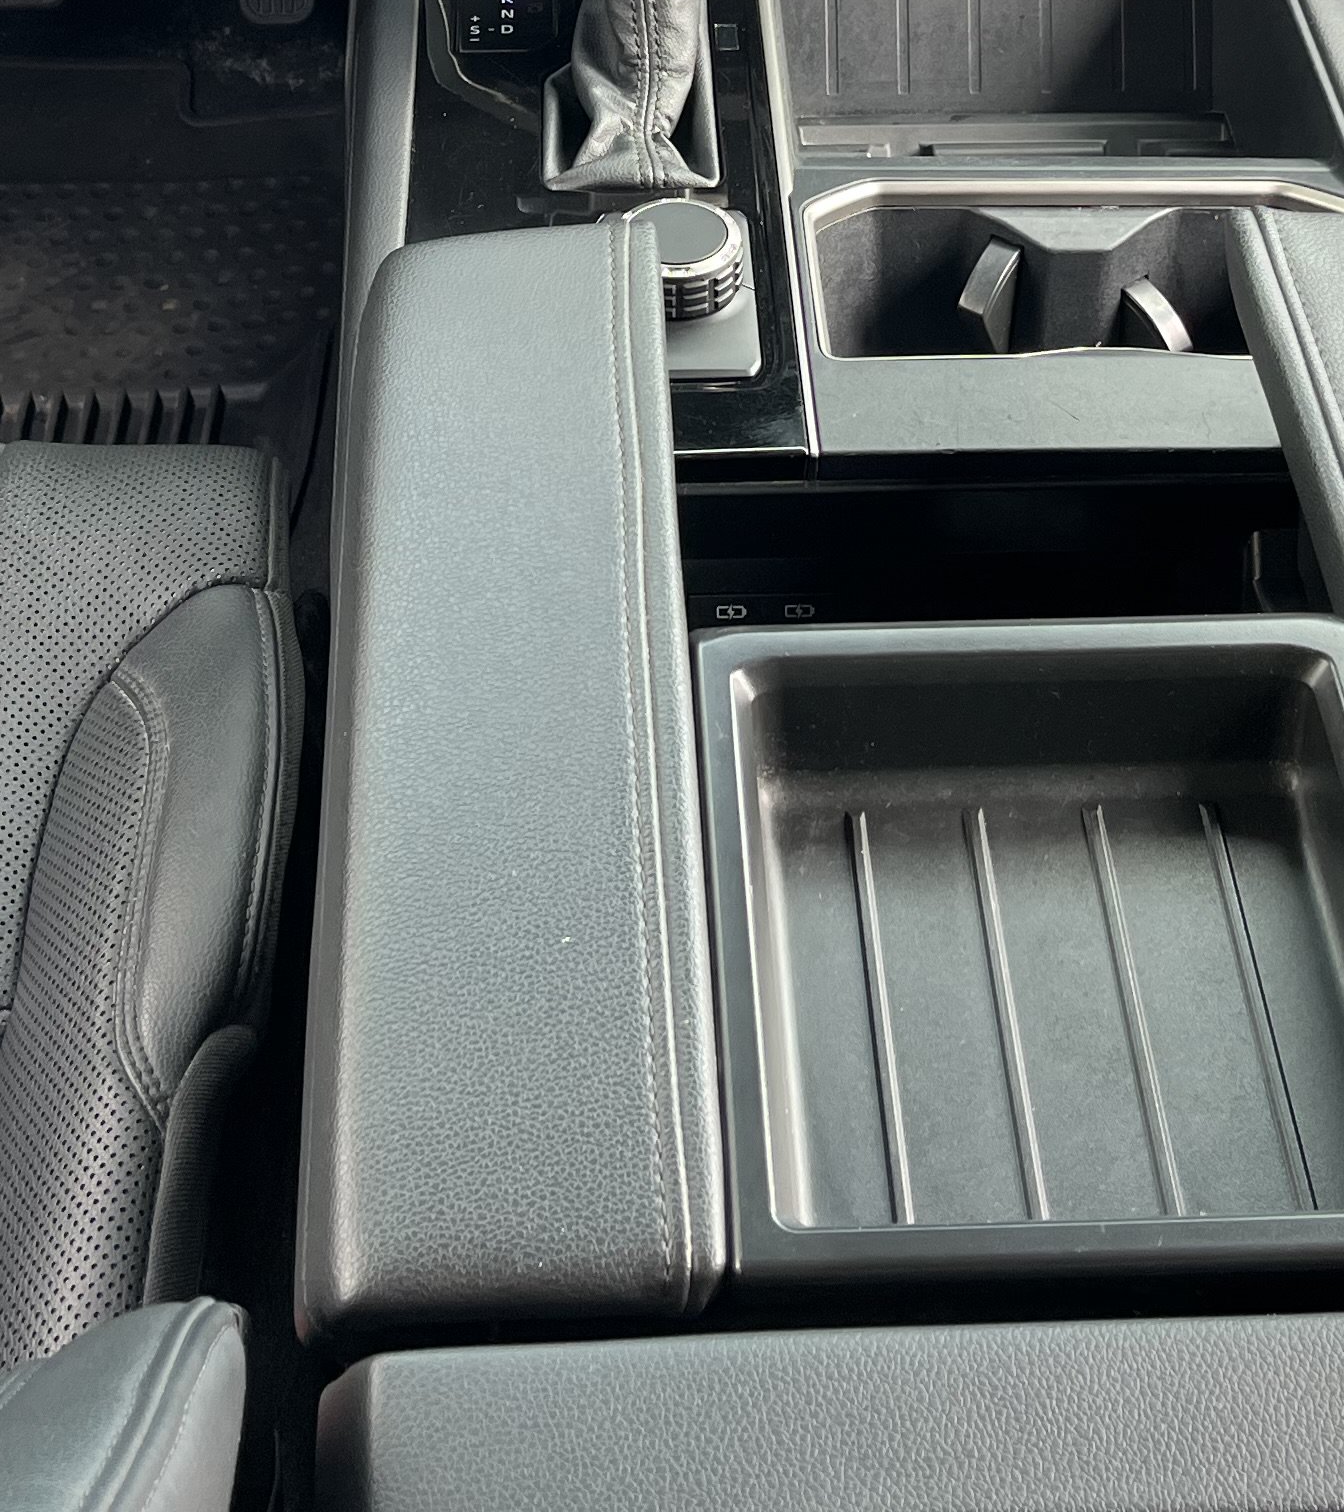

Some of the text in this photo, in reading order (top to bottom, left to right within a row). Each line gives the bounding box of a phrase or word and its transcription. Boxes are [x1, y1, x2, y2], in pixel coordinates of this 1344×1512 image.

[501, 9, 514, 20] N
[469, 24, 481, 35] S
[501, 24, 514, 35] D
